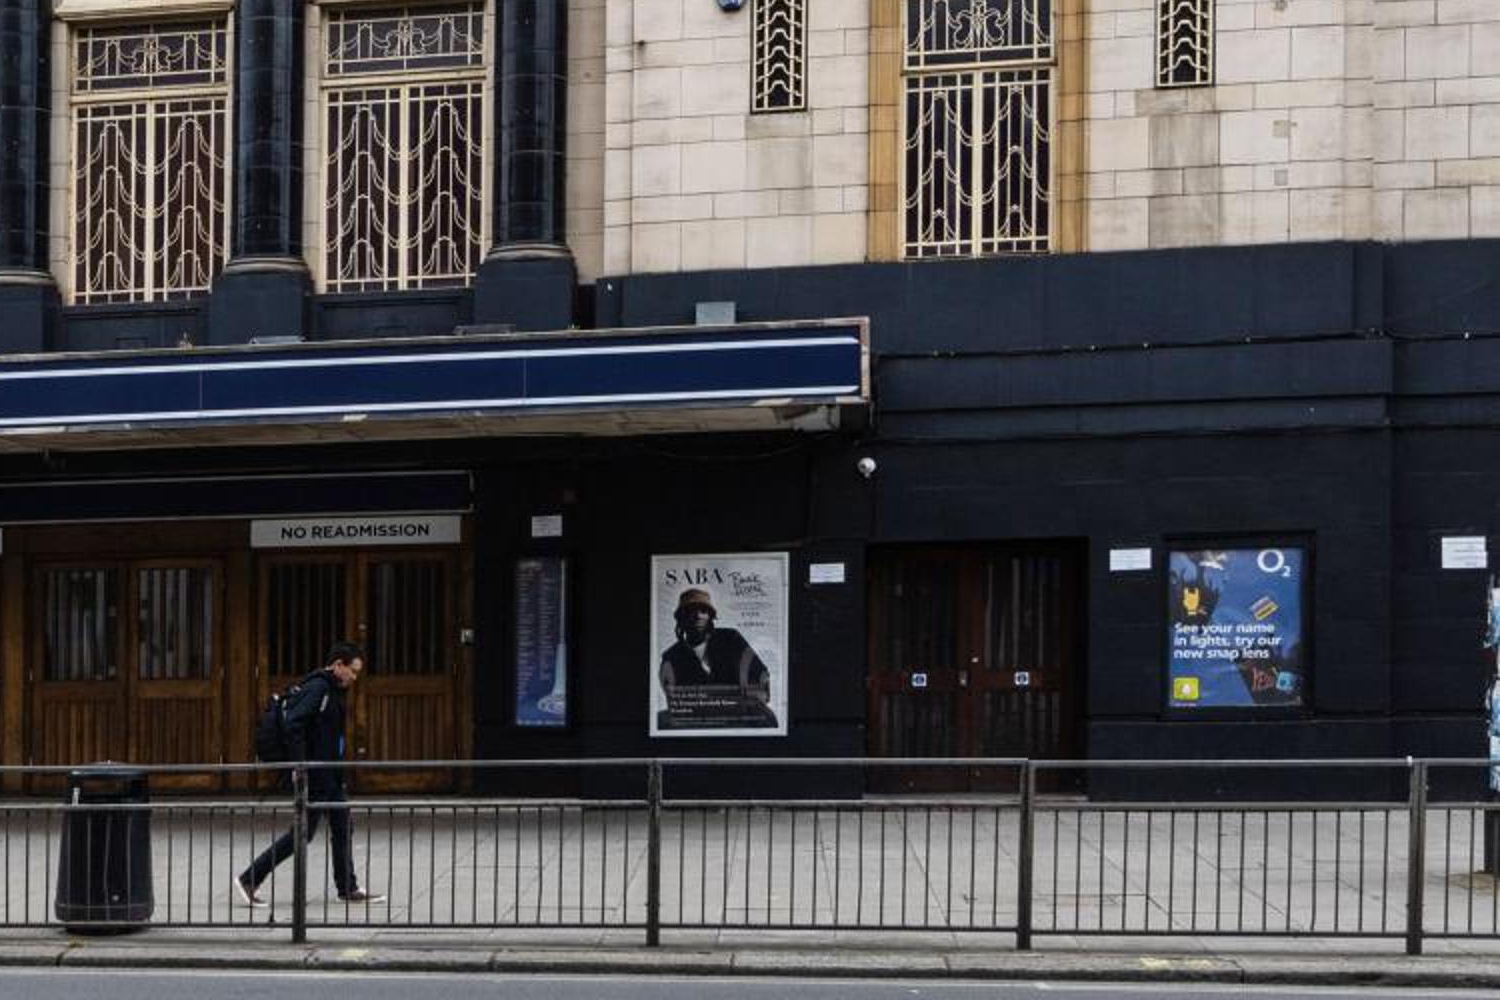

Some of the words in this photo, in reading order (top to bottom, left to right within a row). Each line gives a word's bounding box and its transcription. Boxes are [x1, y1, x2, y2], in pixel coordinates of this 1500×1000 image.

[280, 525, 306, 540] NO
[311, 523, 430, 539] READMISSION
[665, 567, 725, 585] SABA
[1174, 623, 1199, 634] See
[1201, 624, 1233, 637] your
[1235, 624, 1275, 634] name
[1173, 635, 1187, 647] in
[1235, 636, 1255, 649] try
[1257, 636, 1282, 647] our
[1173, 649, 1205, 659] new
[1206, 649, 1239, 663] snap
[1242, 648, 1270, 659] lens
